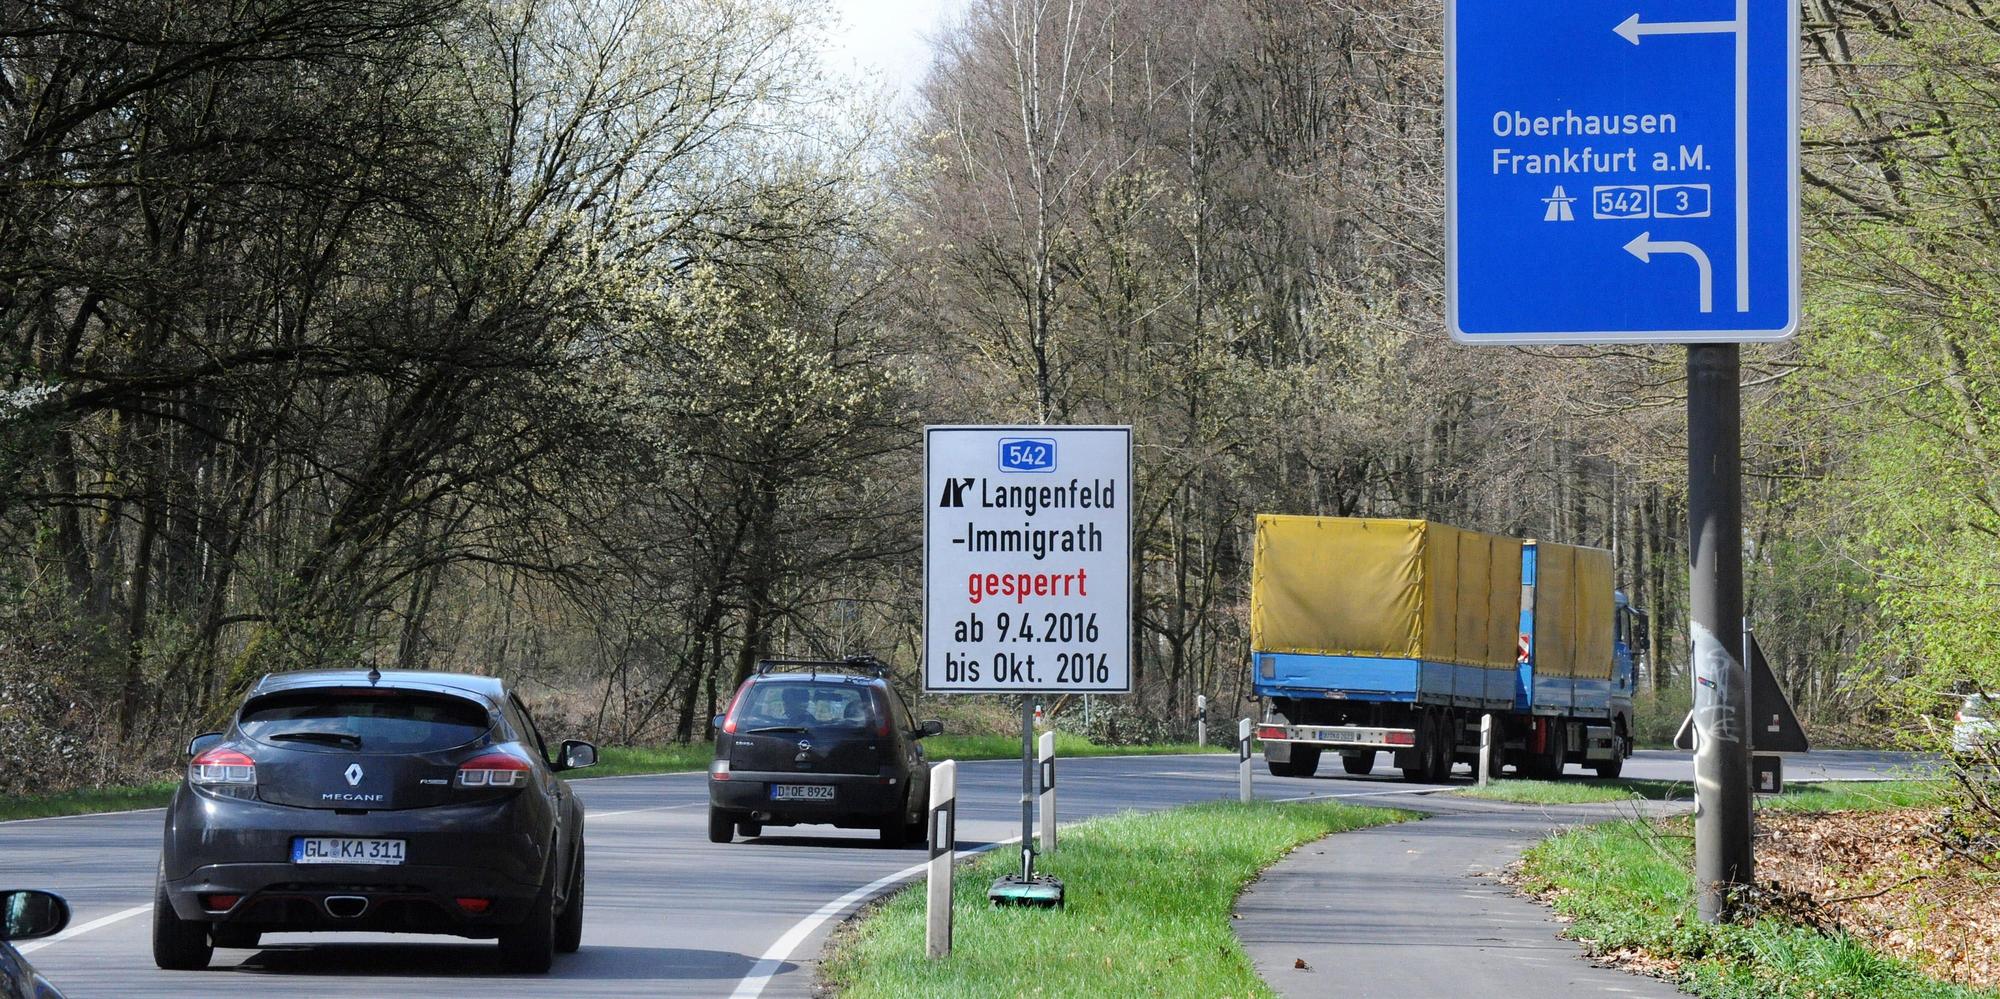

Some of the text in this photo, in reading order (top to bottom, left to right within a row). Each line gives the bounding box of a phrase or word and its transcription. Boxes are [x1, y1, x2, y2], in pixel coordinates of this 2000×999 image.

[1492, 109, 1677, 137] Oberhausen
[1492, 144, 1711, 175] Frankfurt a.M.
[1600, 191, 1689, 213] 542 3
[1009, 446, 1046, 465] 542
[981, 478, 1115, 516] Langenfeld
[952, 522, 1103, 560] -Immigrath
[968, 568, 1087, 604] gesperrt
[954, 612, 1099, 643] ab 9.4.2016
[945, 652, 1109, 683] bis Okt. 2016
[322, 793, 384, 801] MEGANE
[778, 786, 785, 797] D
[807, 786, 833, 798] 8924
[304, 840, 403, 859] GL KA 311
